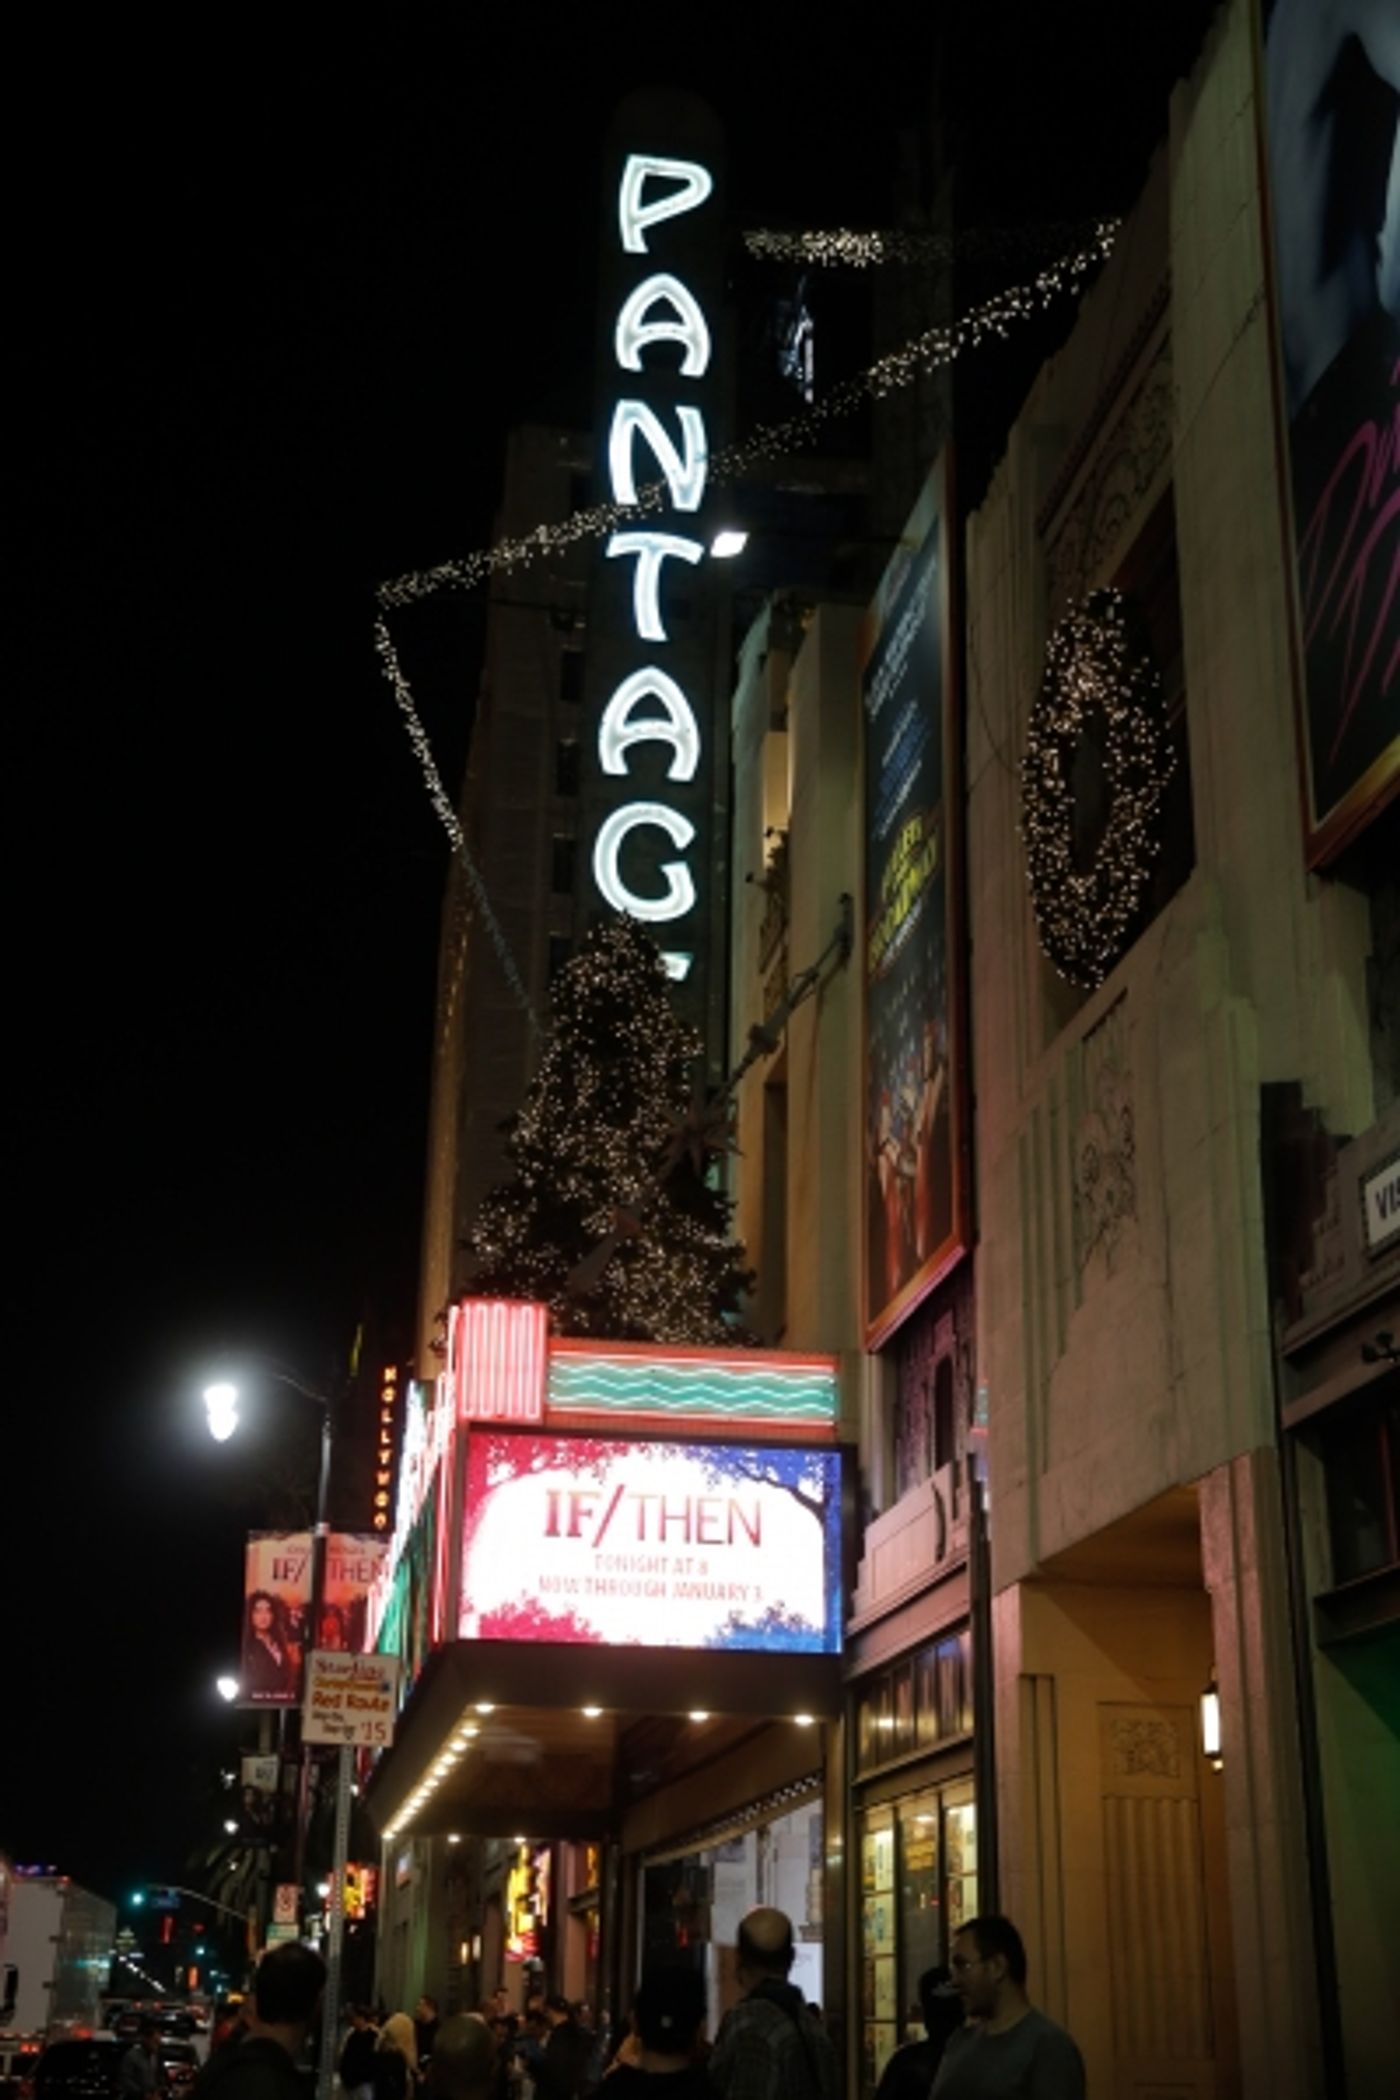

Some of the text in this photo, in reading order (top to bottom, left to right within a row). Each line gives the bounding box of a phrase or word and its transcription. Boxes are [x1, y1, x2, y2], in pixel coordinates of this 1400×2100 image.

[593, 153, 713, 981] PANTAG
[543, 1483, 762, 1549] IF/THEN
[539, 1574, 579, 1595] NOW
[583, 1576, 667, 1599] THROUGH
[671, 1580, 750, 1602] JANUARY
[594, 1554, 668, 1575] TONIGHT
[672, 1557, 695, 1576] AT
